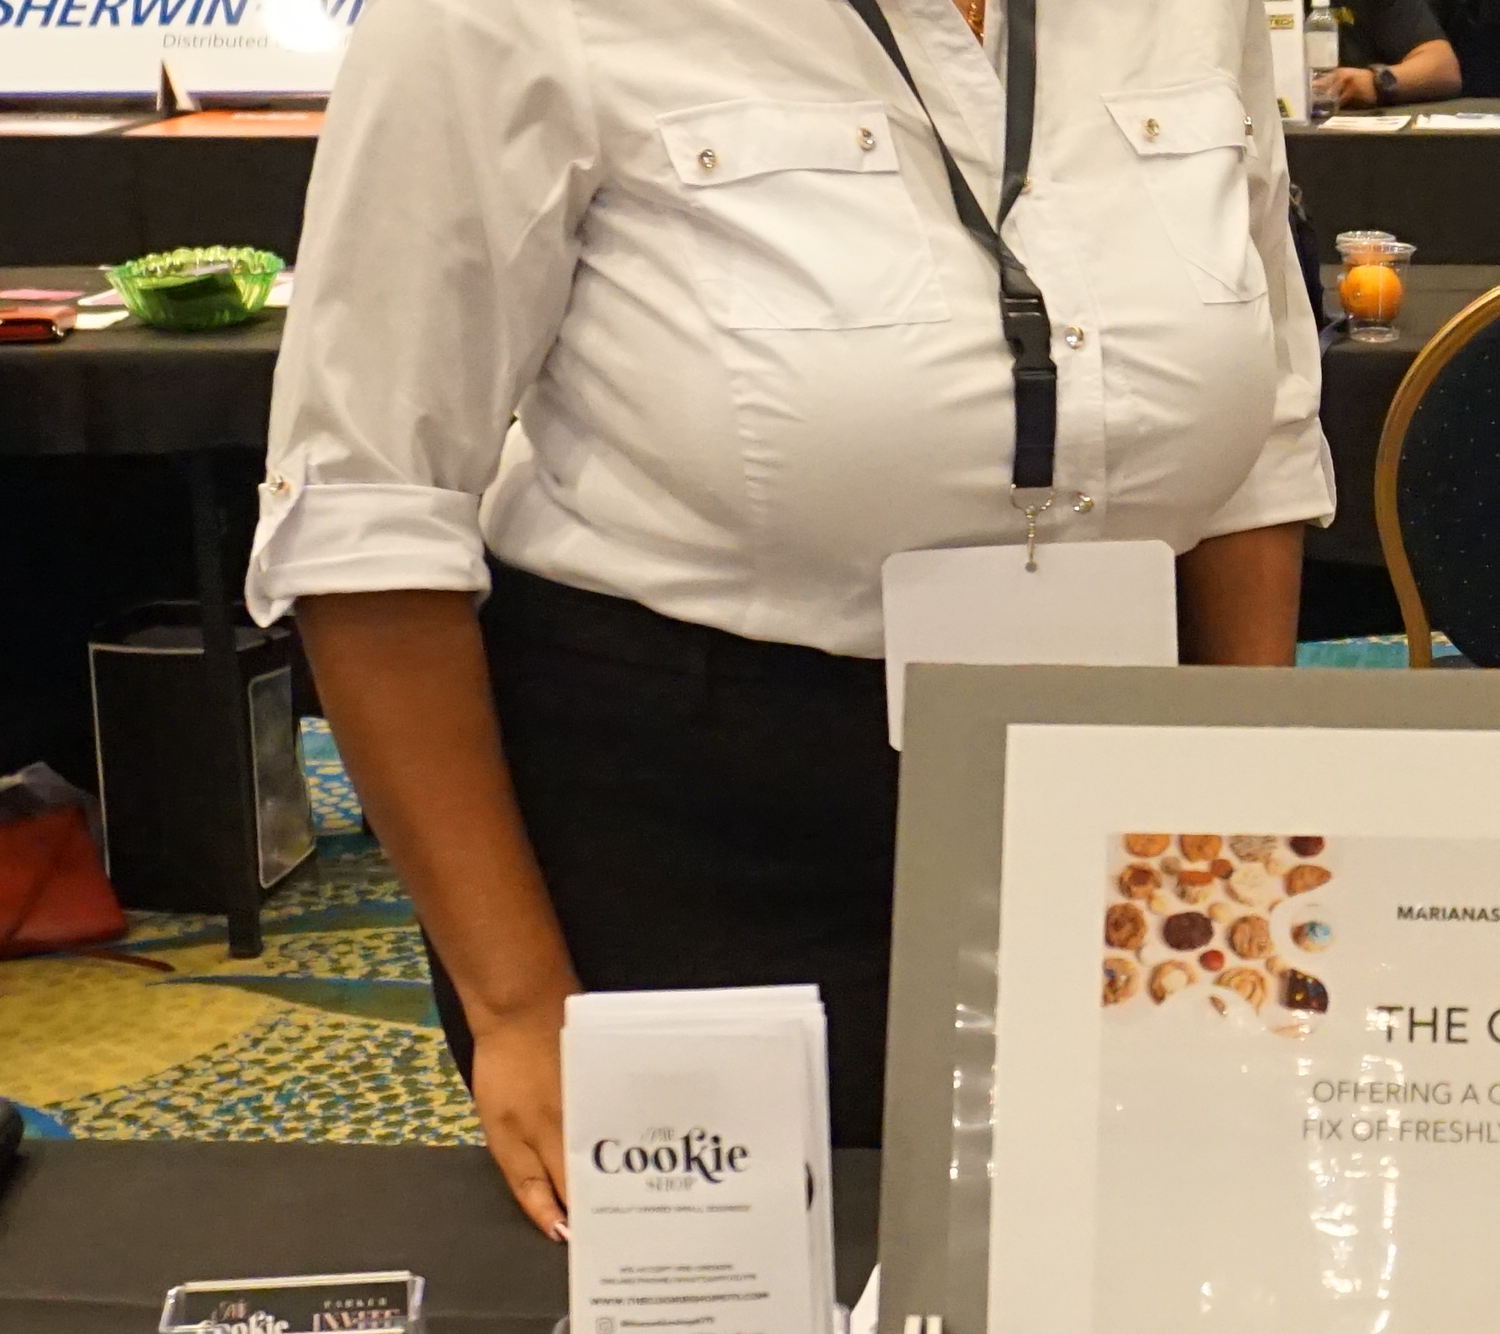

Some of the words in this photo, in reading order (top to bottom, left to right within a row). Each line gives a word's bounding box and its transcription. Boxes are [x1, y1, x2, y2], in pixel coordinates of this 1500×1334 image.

[162, 32, 269, 49] Distributed
[1396, 904, 1500, 924] MARIANAS
[1374, 1005, 1469, 1046] THE
[1311, 1079, 1453, 1108] OFFERING
[1459, 1082, 1481, 1107] A
[1301, 1119, 1344, 1143] FIX
[1351, 1120, 1392, 1144] OF
[592, 1126, 750, 1185] Cookie
